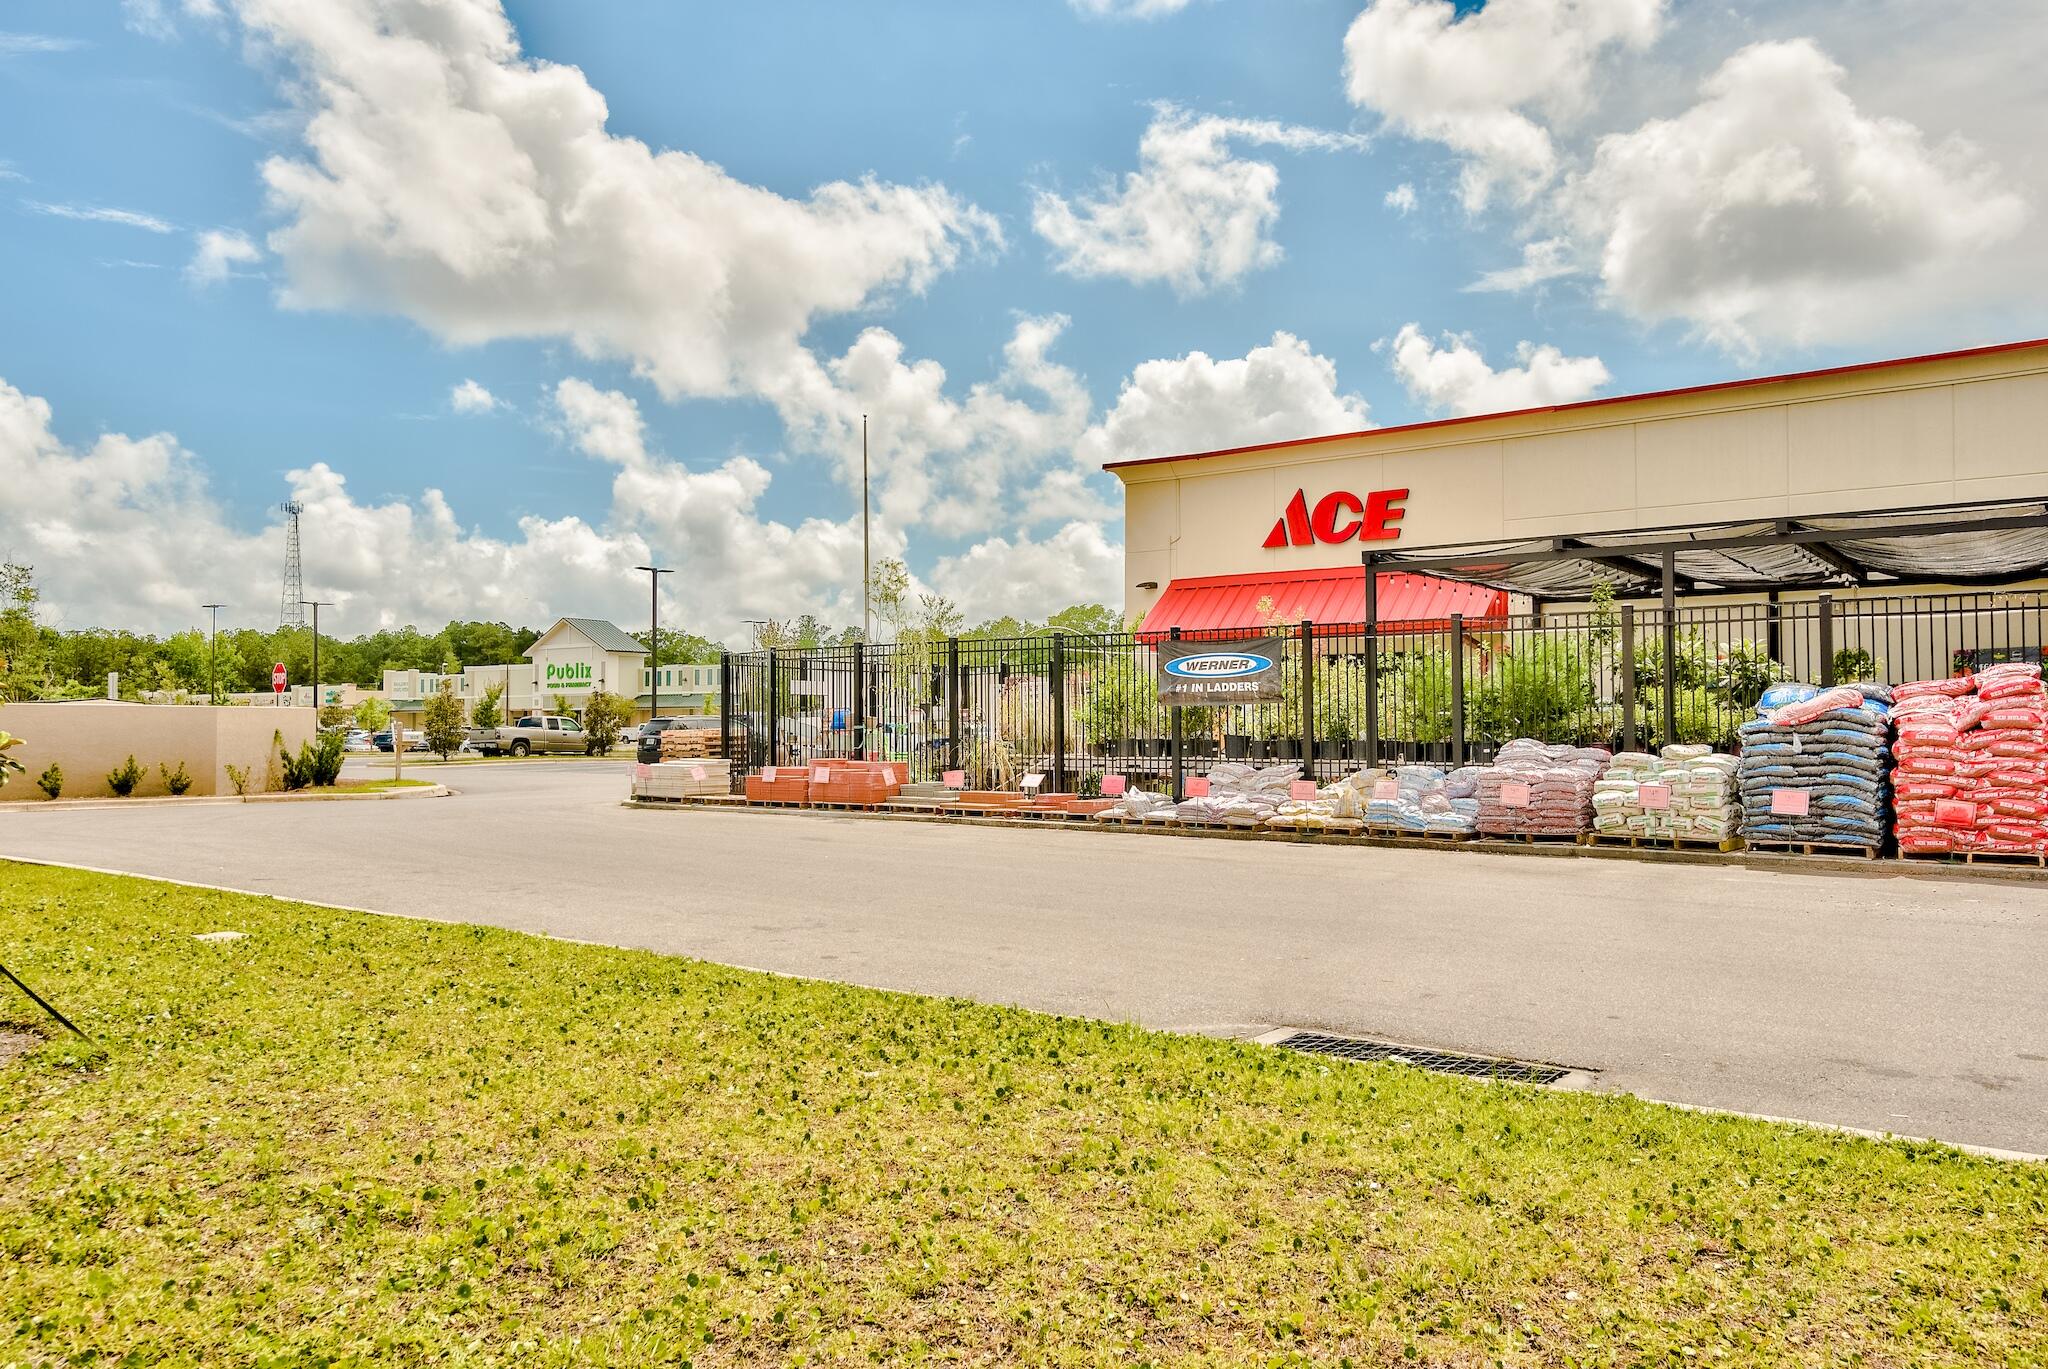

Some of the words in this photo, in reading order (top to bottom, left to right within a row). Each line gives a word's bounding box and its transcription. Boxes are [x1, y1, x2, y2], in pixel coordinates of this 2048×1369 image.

[1262, 488, 1409, 547] ACE
[547, 662, 592, 680] Publix
[1186, 660, 1250, 671] WERNER
[274, 672, 286, 684] STOP
[1175, 684, 1187, 693] #1
[1191, 683, 1204, 692] IN
[1207, 681, 1260, 692] LADDERS
[2012, 776, 2033, 784] MULCH
[2013, 804, 2035, 812] MULCH
[2010, 829, 2032, 837] MULCH
